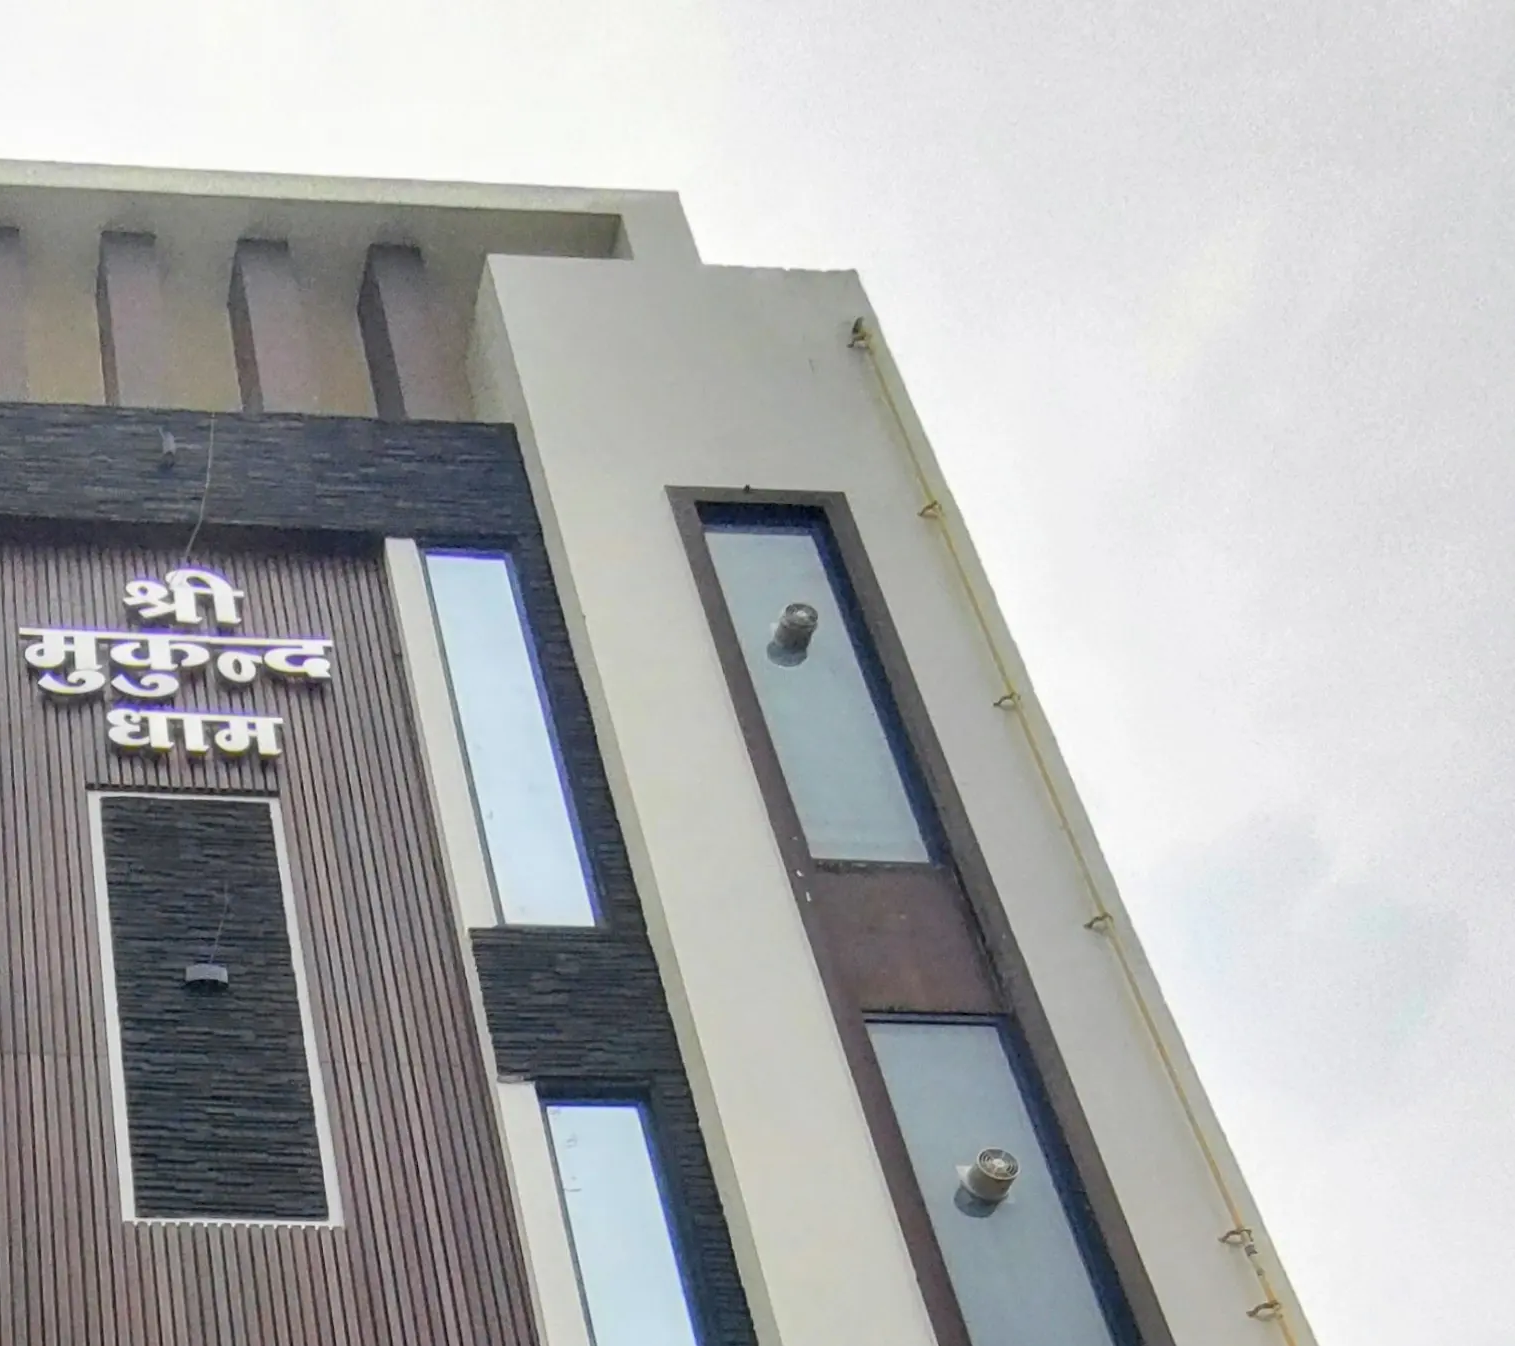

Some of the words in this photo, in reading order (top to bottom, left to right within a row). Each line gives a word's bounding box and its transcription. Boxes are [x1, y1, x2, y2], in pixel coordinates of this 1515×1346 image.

[123, 568, 245, 625] श्री
[18, 626, 334, 698] मुकुन्द
[106, 706, 284, 757] धाम
